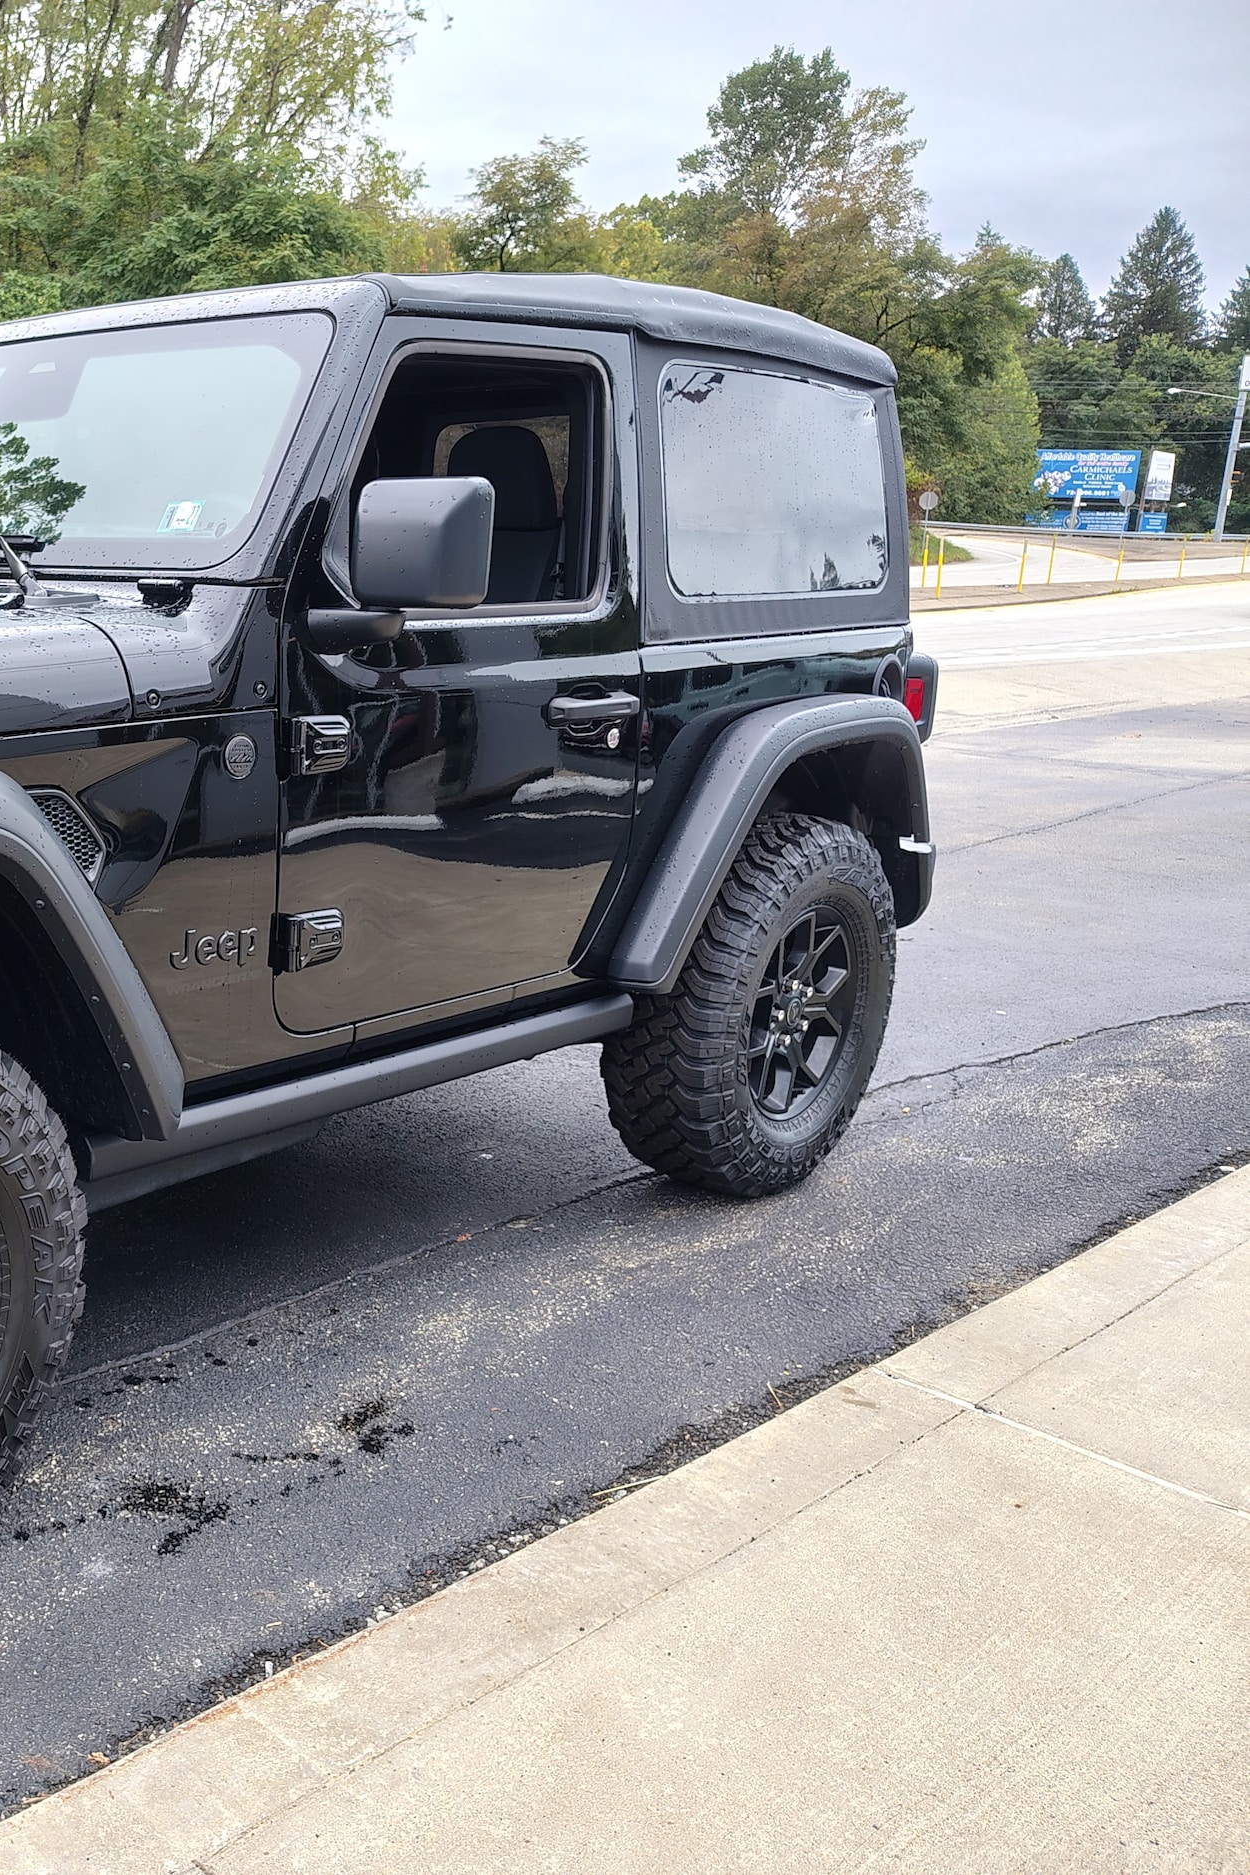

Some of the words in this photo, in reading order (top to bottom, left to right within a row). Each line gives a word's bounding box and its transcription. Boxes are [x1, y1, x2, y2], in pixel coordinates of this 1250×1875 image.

[1076, 452, 1099, 462] Quality
[1100, 453, 1136, 461] Healthcare
[1070, 465, 1133, 474] CARMICHAELS
[1084, 473, 1116, 481] CLINIC
[169, 927, 259, 970] Jeep
